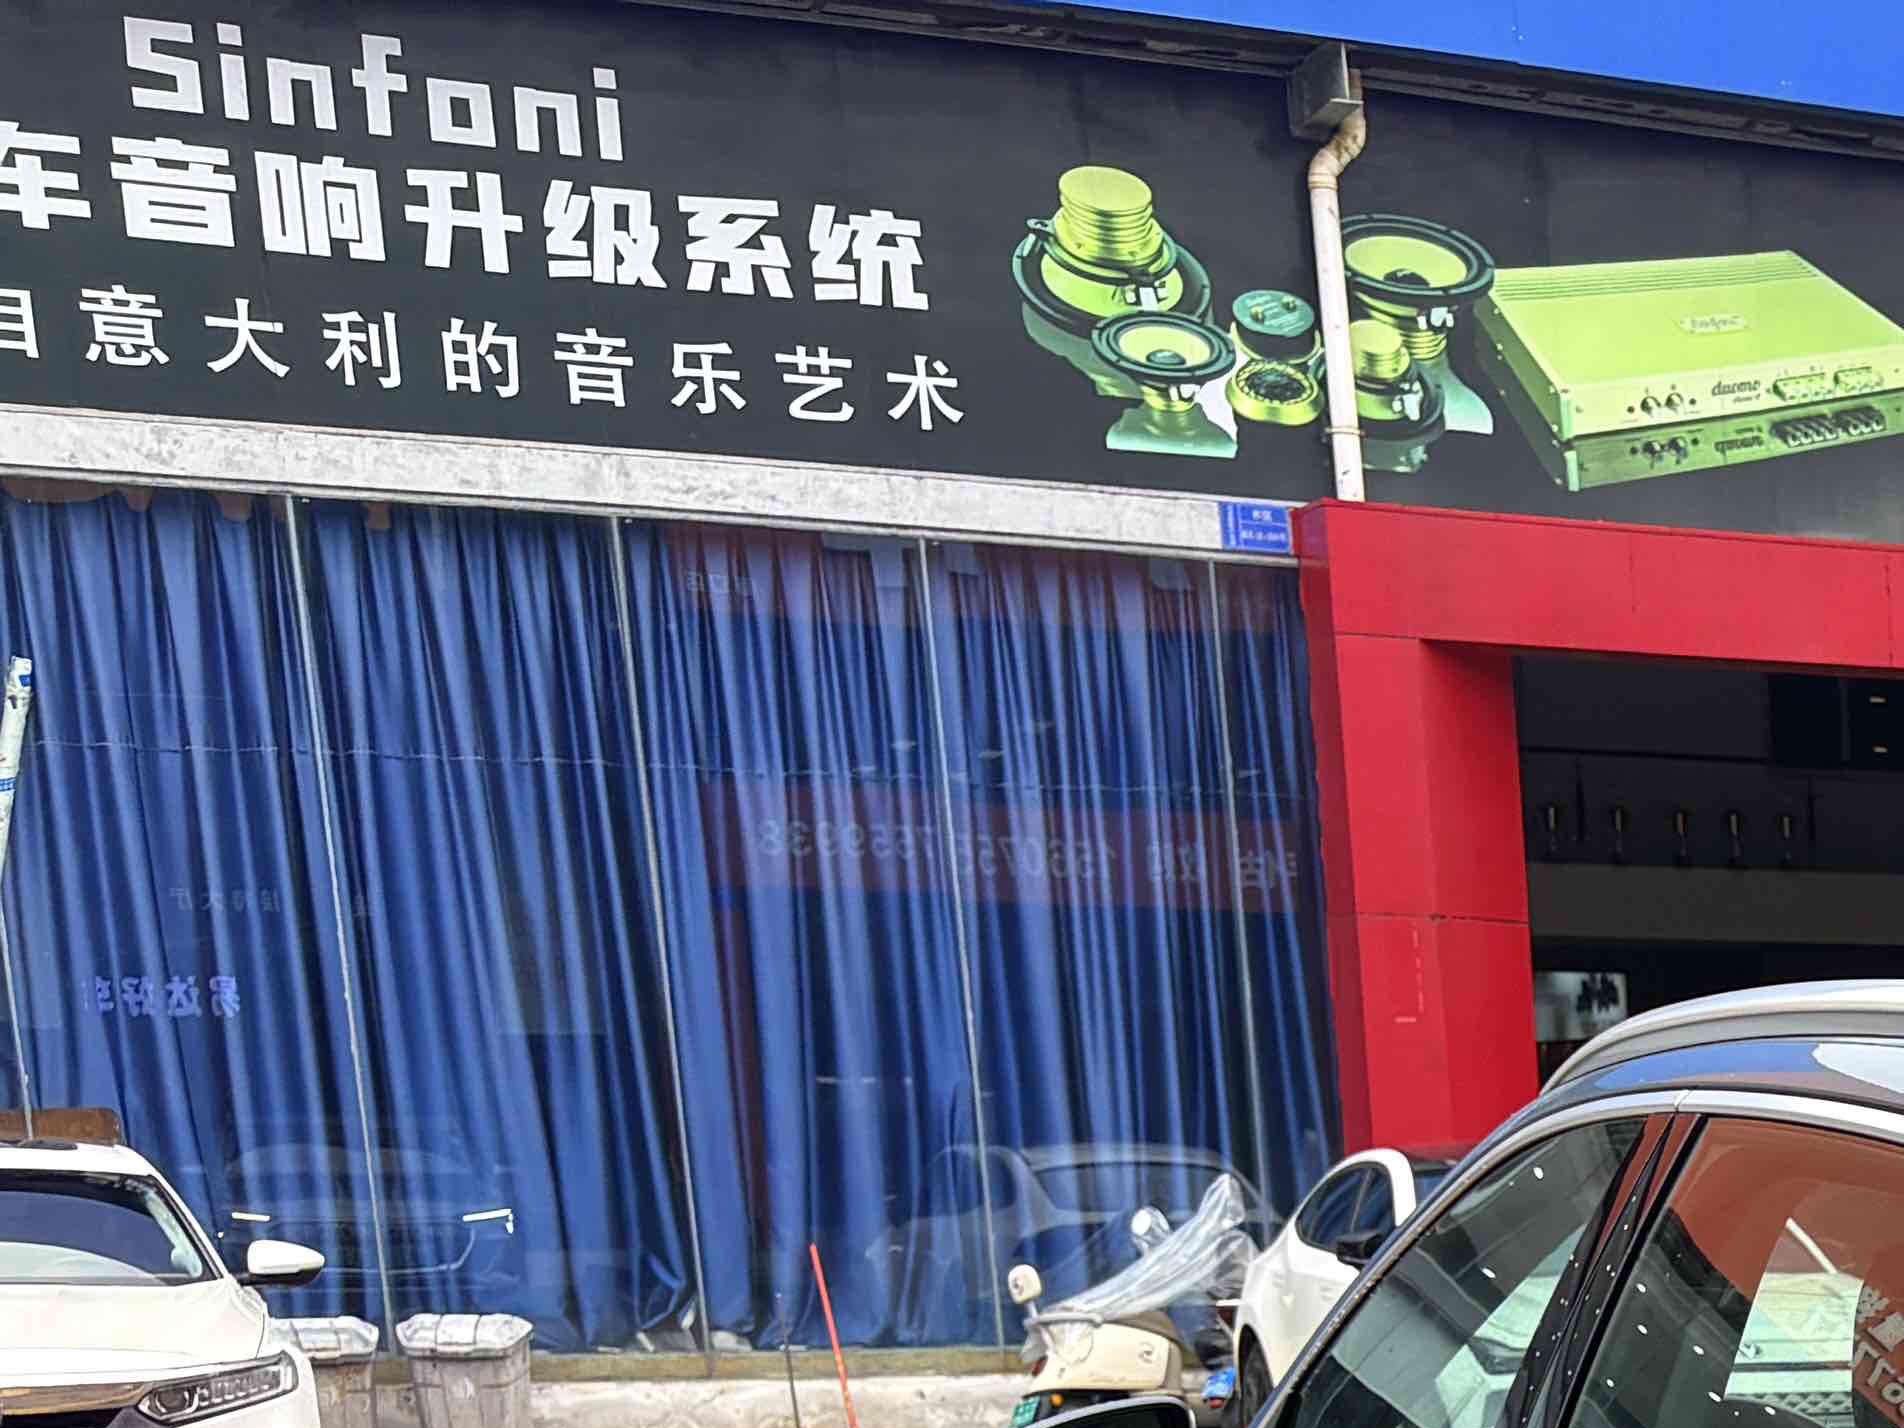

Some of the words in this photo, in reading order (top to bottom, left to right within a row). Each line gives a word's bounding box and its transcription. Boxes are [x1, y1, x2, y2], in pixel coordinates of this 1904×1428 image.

[122, 14, 625, 162] Sinfoni
[0, 119, 931, 312] 车音响升级系统
